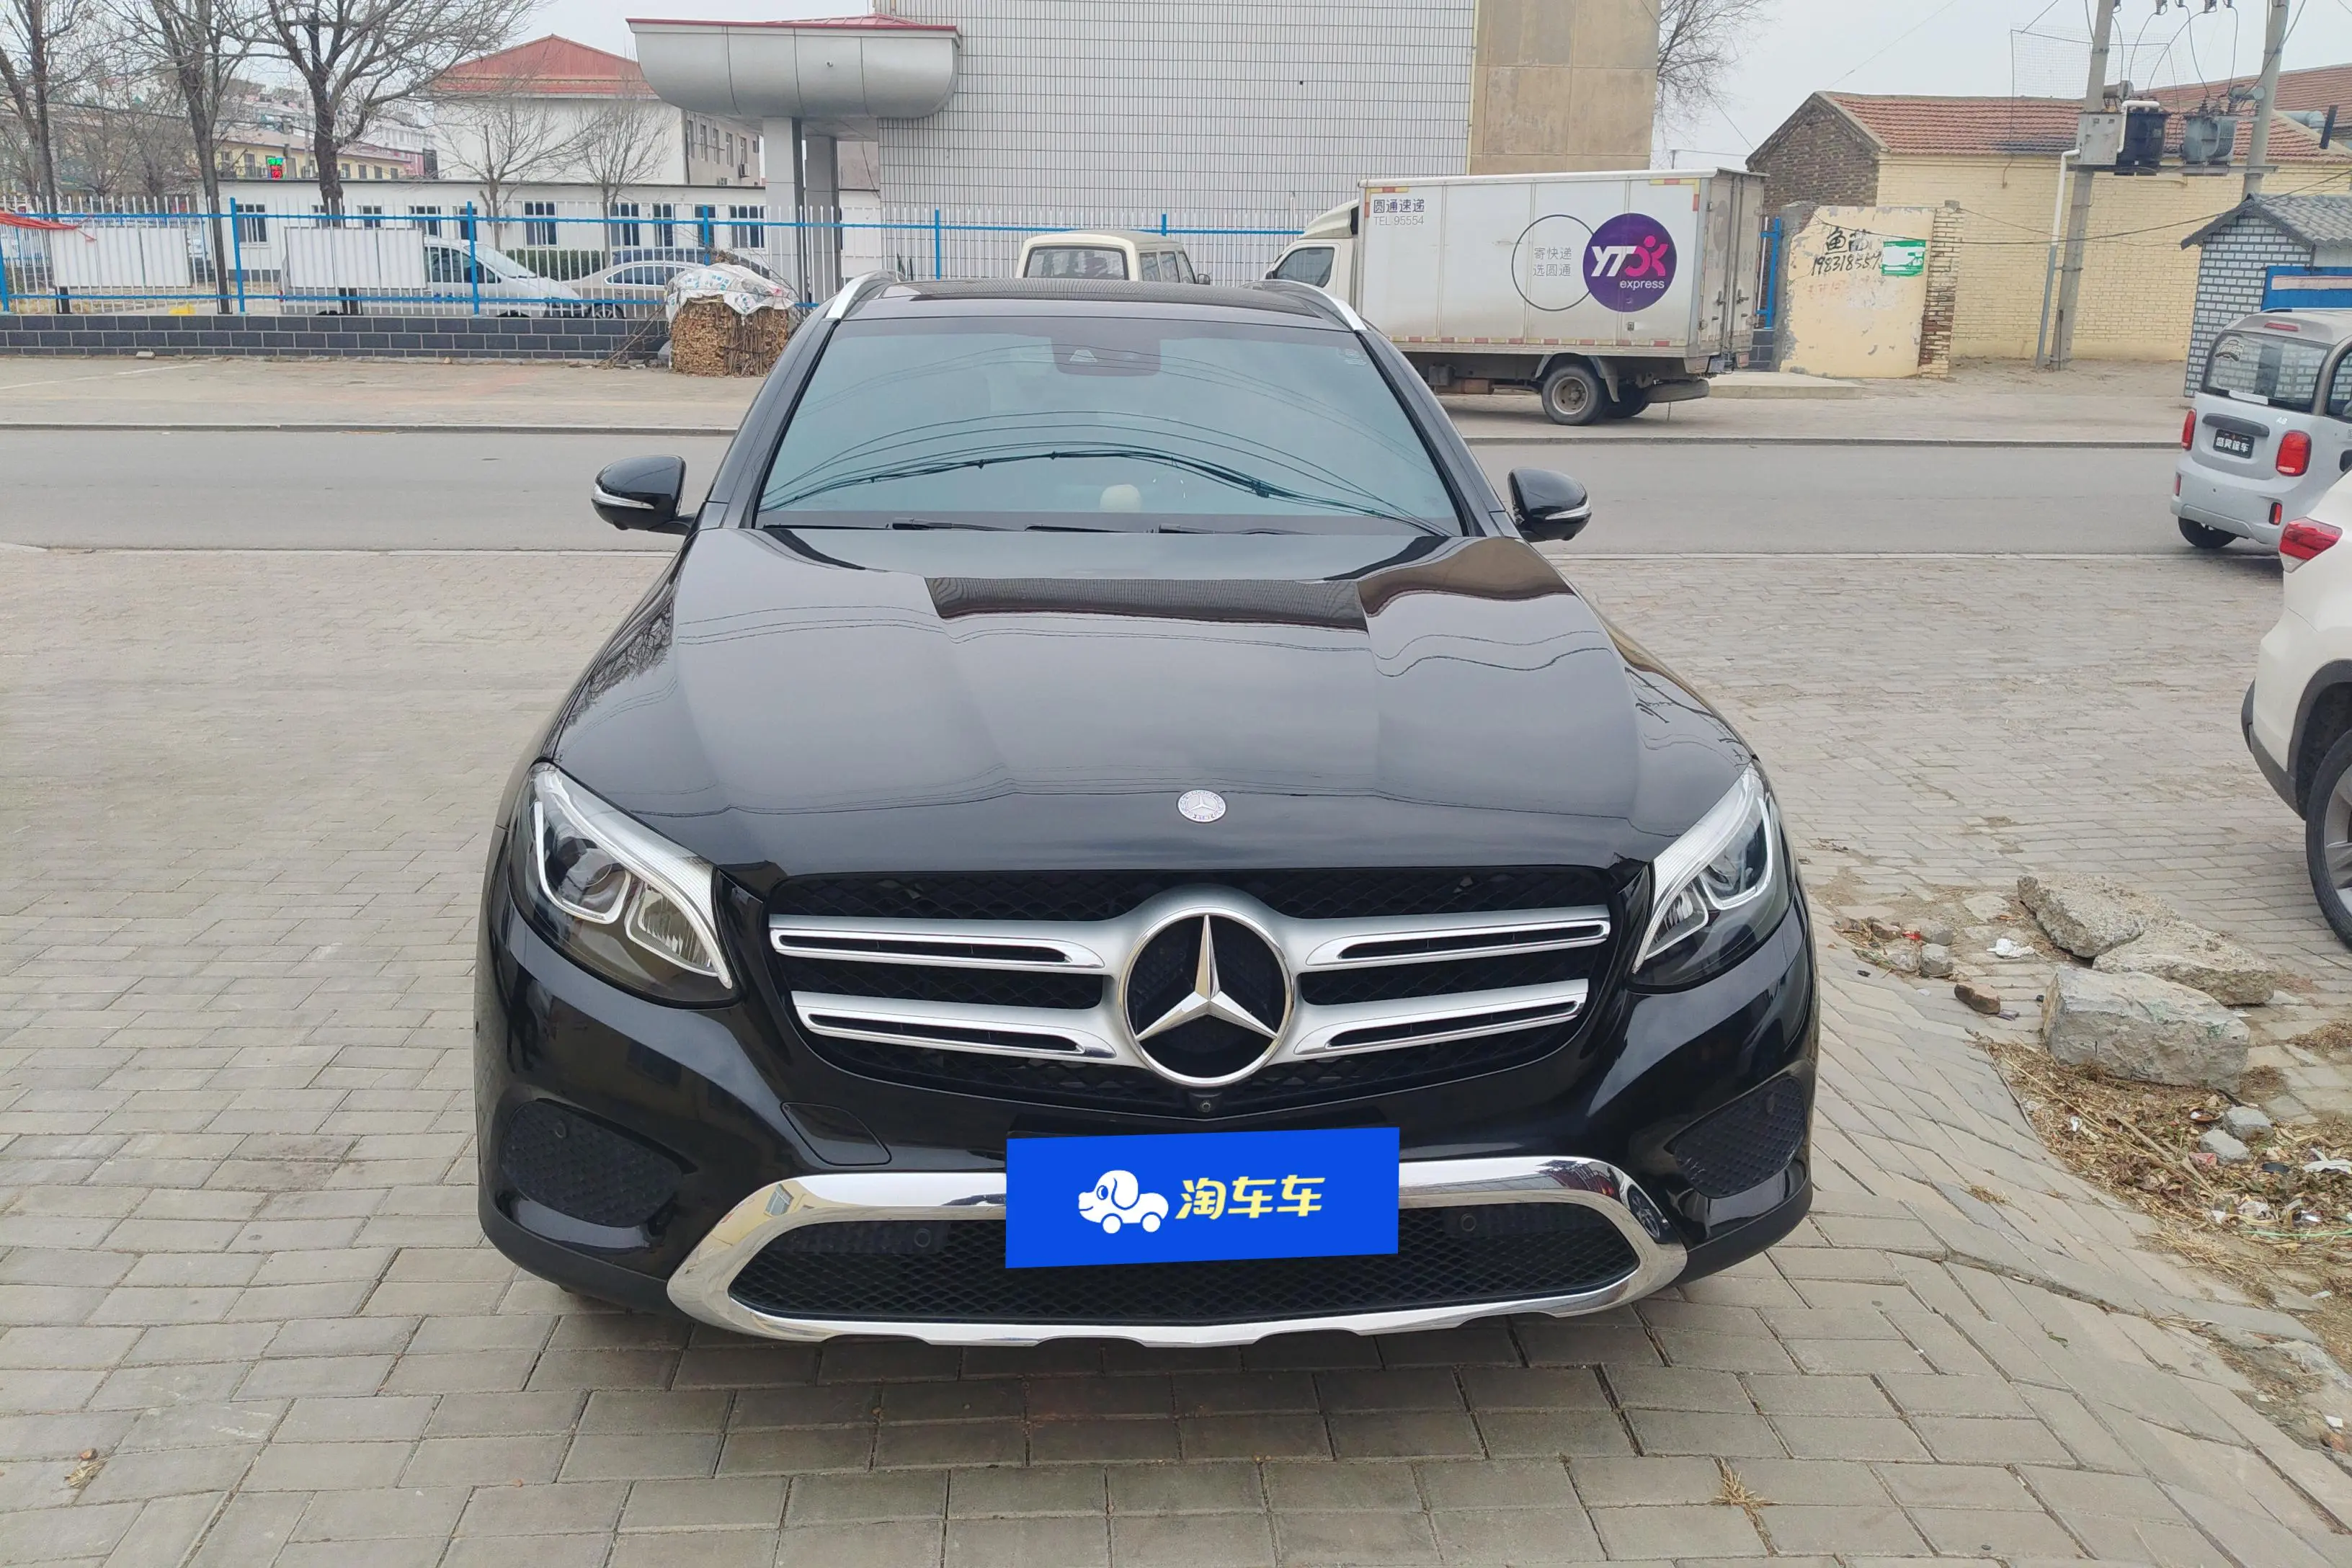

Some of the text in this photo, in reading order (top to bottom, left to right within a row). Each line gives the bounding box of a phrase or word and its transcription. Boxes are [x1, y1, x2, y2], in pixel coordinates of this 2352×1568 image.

[1373, 198, 1425, 213] 圆通速递
[1373, 215, 1425, 226] TEL 95554
[1533, 246, 1572, 260] 寄快递
[1533, 264, 1572, 277] 选圆通
[1619, 280, 1665, 290] express
